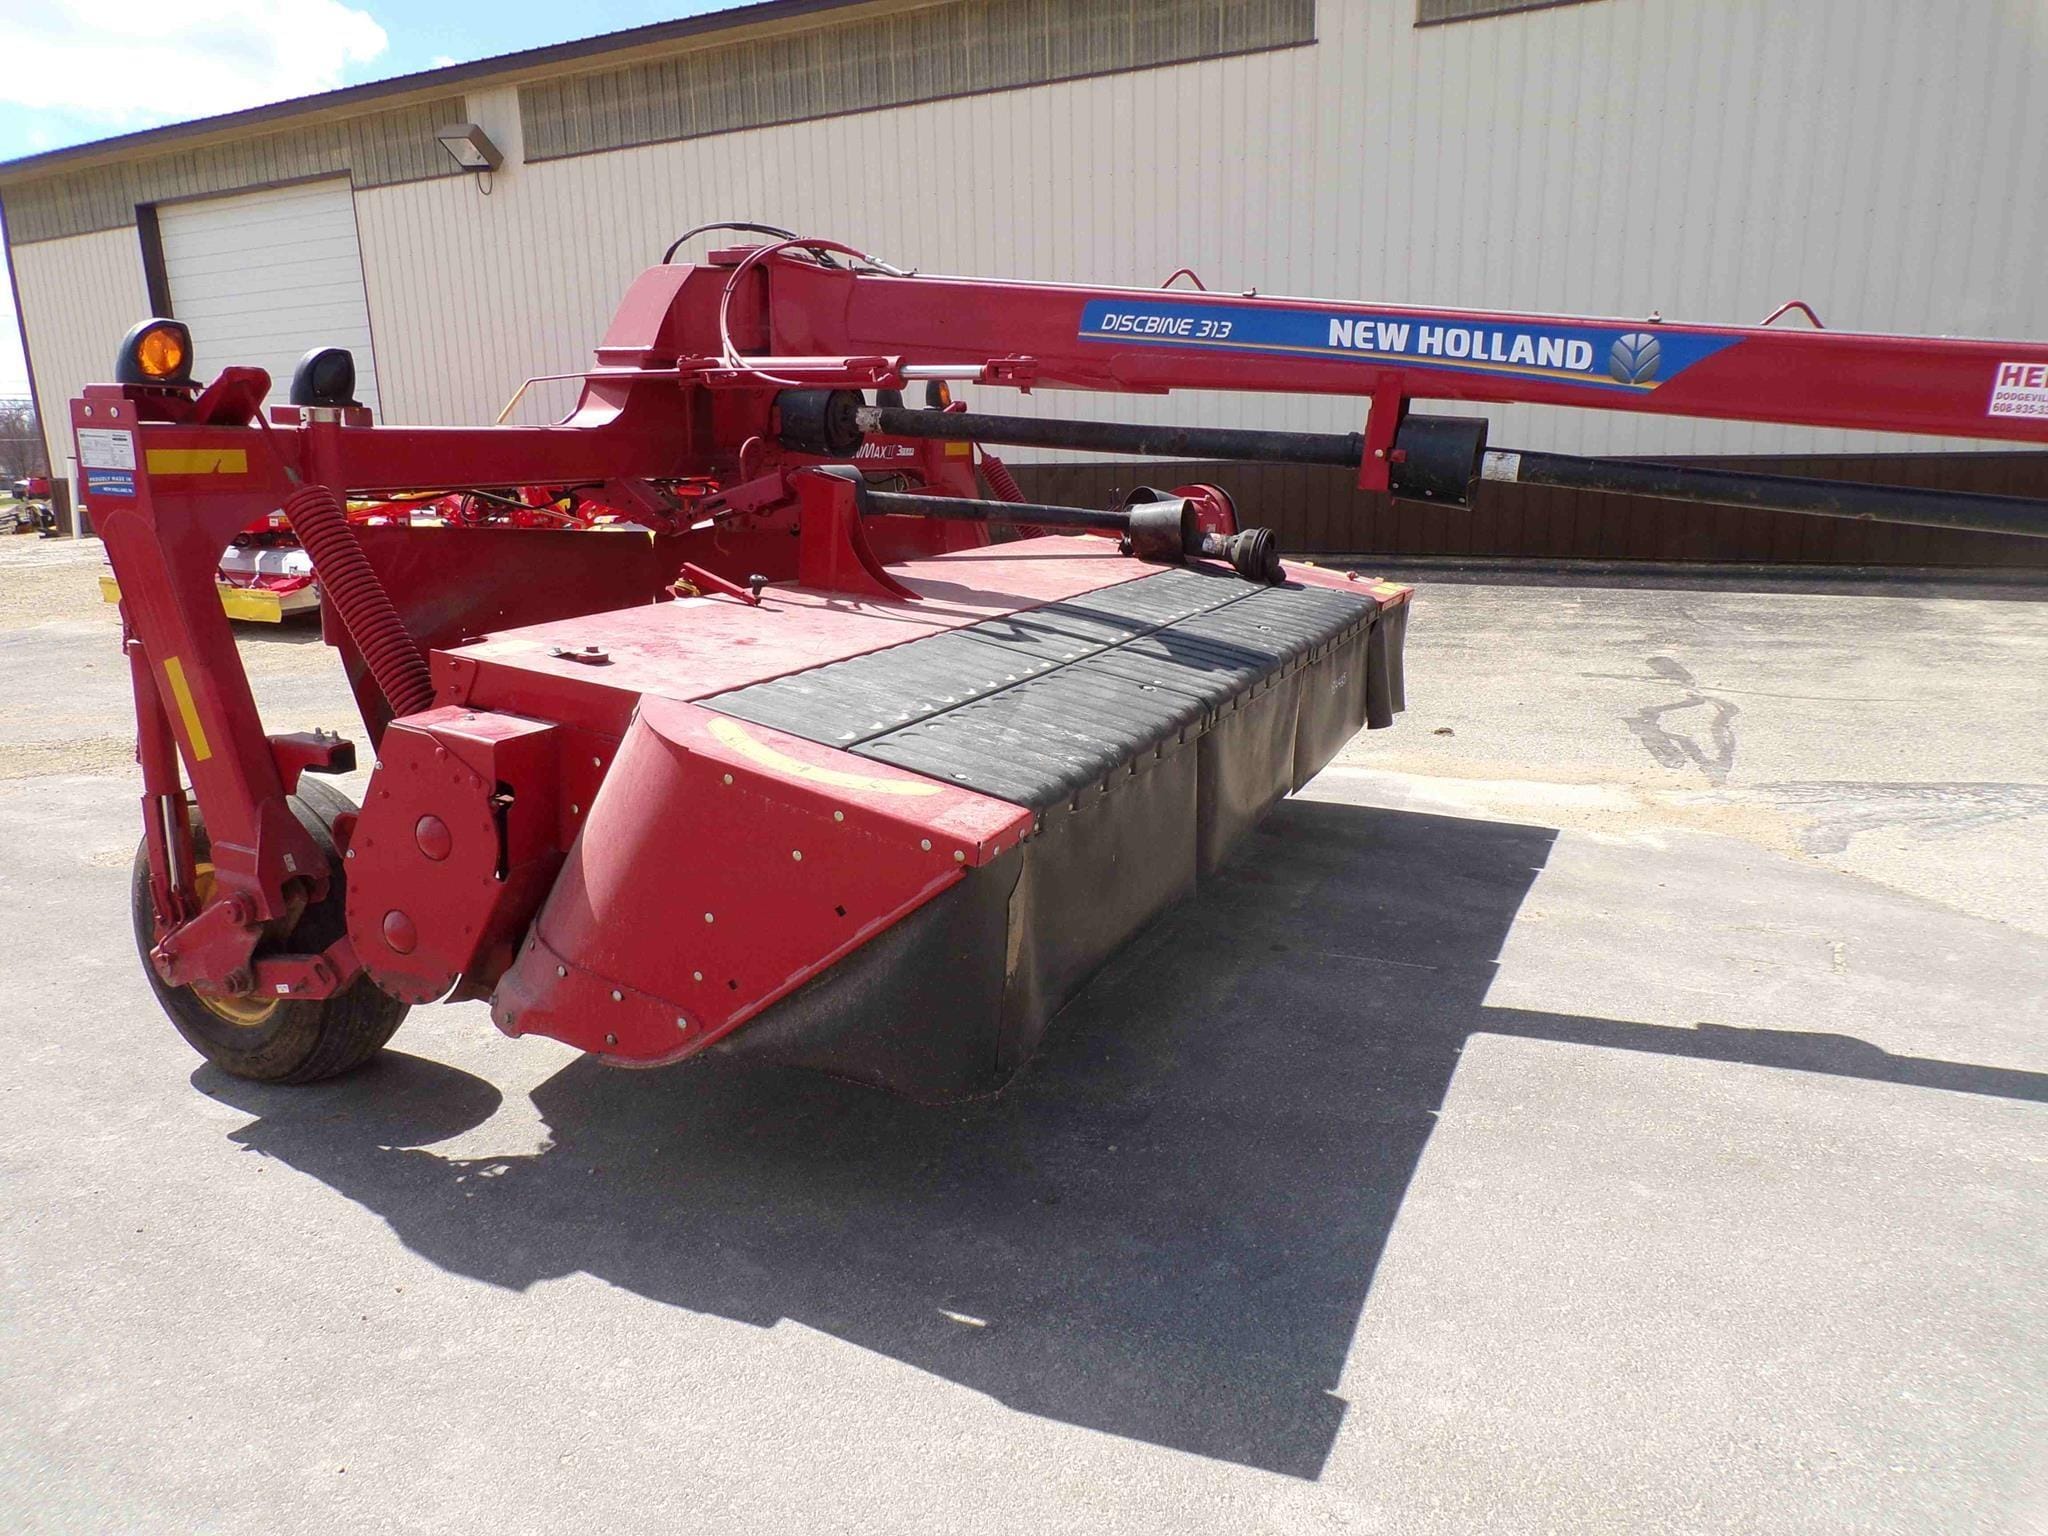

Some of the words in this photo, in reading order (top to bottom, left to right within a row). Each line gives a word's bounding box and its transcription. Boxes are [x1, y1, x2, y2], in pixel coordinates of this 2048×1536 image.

[1101, 313, 1194, 336] DISCBINE
[1196, 319, 1232, 338] 313
[1328, 318, 1410, 352] NEW
[1417, 325, 1594, 371] HOLLAND
[2000, 365, 2048, 388] HE
